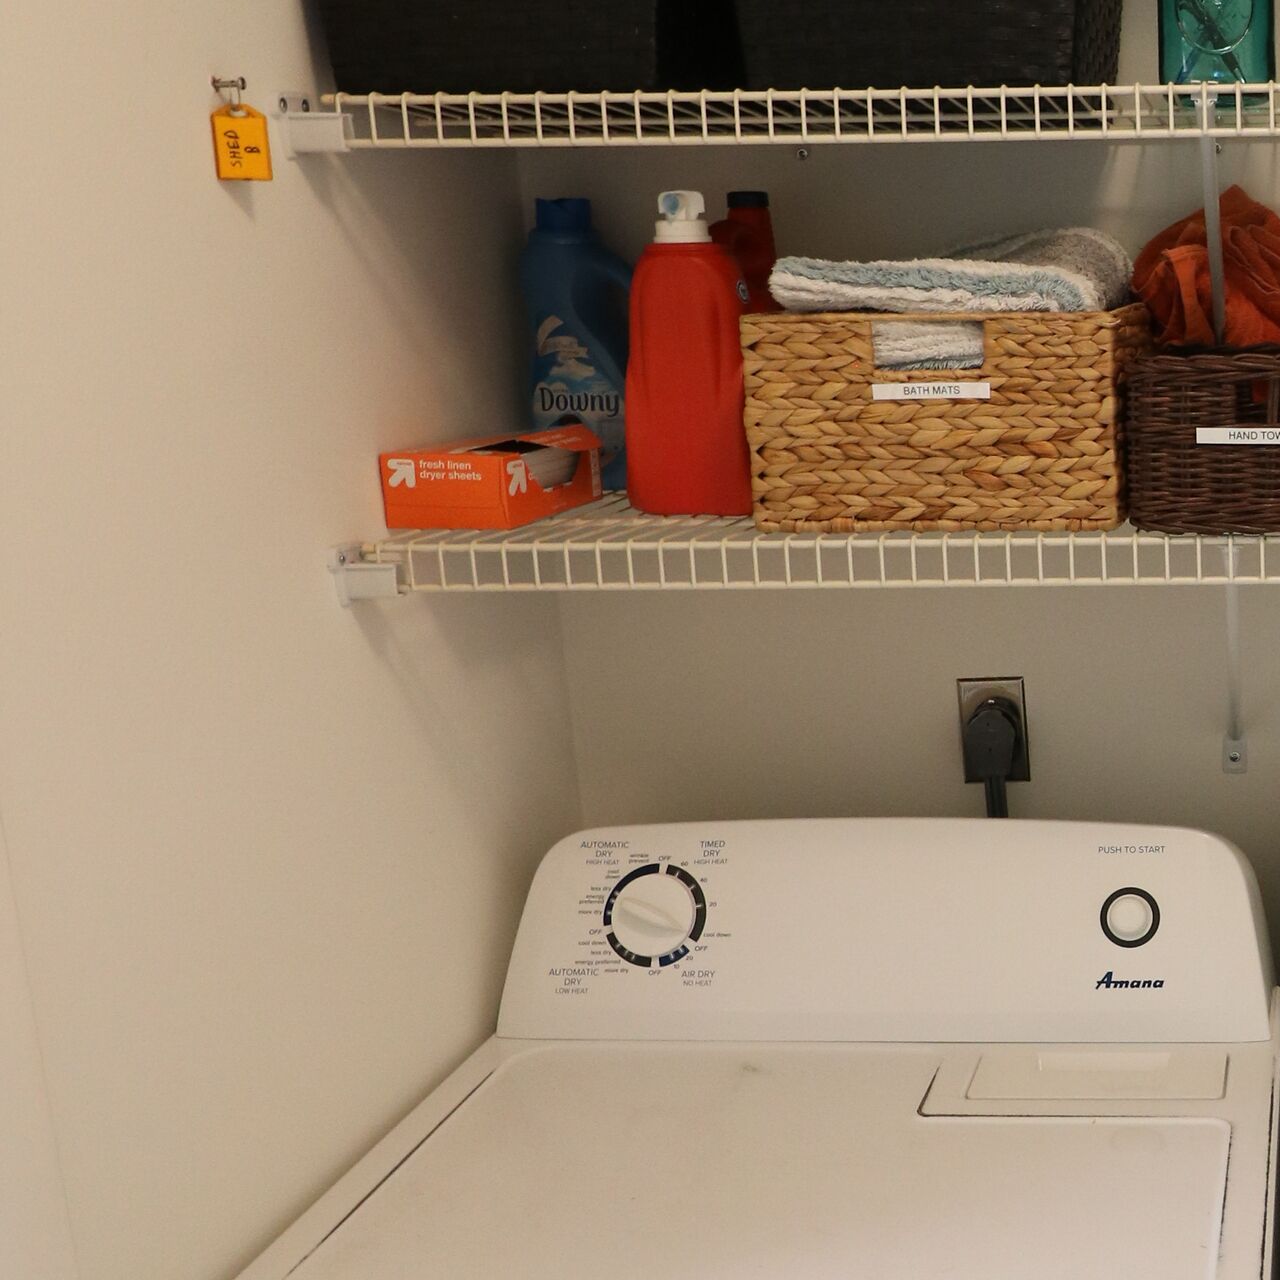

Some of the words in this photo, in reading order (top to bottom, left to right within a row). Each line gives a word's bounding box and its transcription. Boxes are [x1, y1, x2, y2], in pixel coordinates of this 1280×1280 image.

[223, 130, 243, 168] SHED
[244, 146, 261, 154] B
[903, 386, 930, 396] BATH
[932, 385, 961, 395] MATS
[539, 386, 621, 418] Downy
[1228, 431, 1258, 440] HAND
[419, 459, 445, 470] fresh
[447, 460, 471, 470] linen
[419, 470, 446, 481] dryer
[448, 471, 482, 481] sheets
[580, 841, 630, 849] AUTOMATIC
[700, 840, 726, 848] TIMED
[595, 850, 613, 858] DRY
[1098, 846, 1122, 854] PUSH
[1125, 846, 1136, 854] TO
[1139, 845, 1166, 854] START
[549, 968, 600, 976] AUTOMATIC
[681, 970, 696, 978] AIR
[697, 970, 715, 978] DRY
[564, 978, 582, 986] DRY
[1095, 971, 1165, 990] Amana
